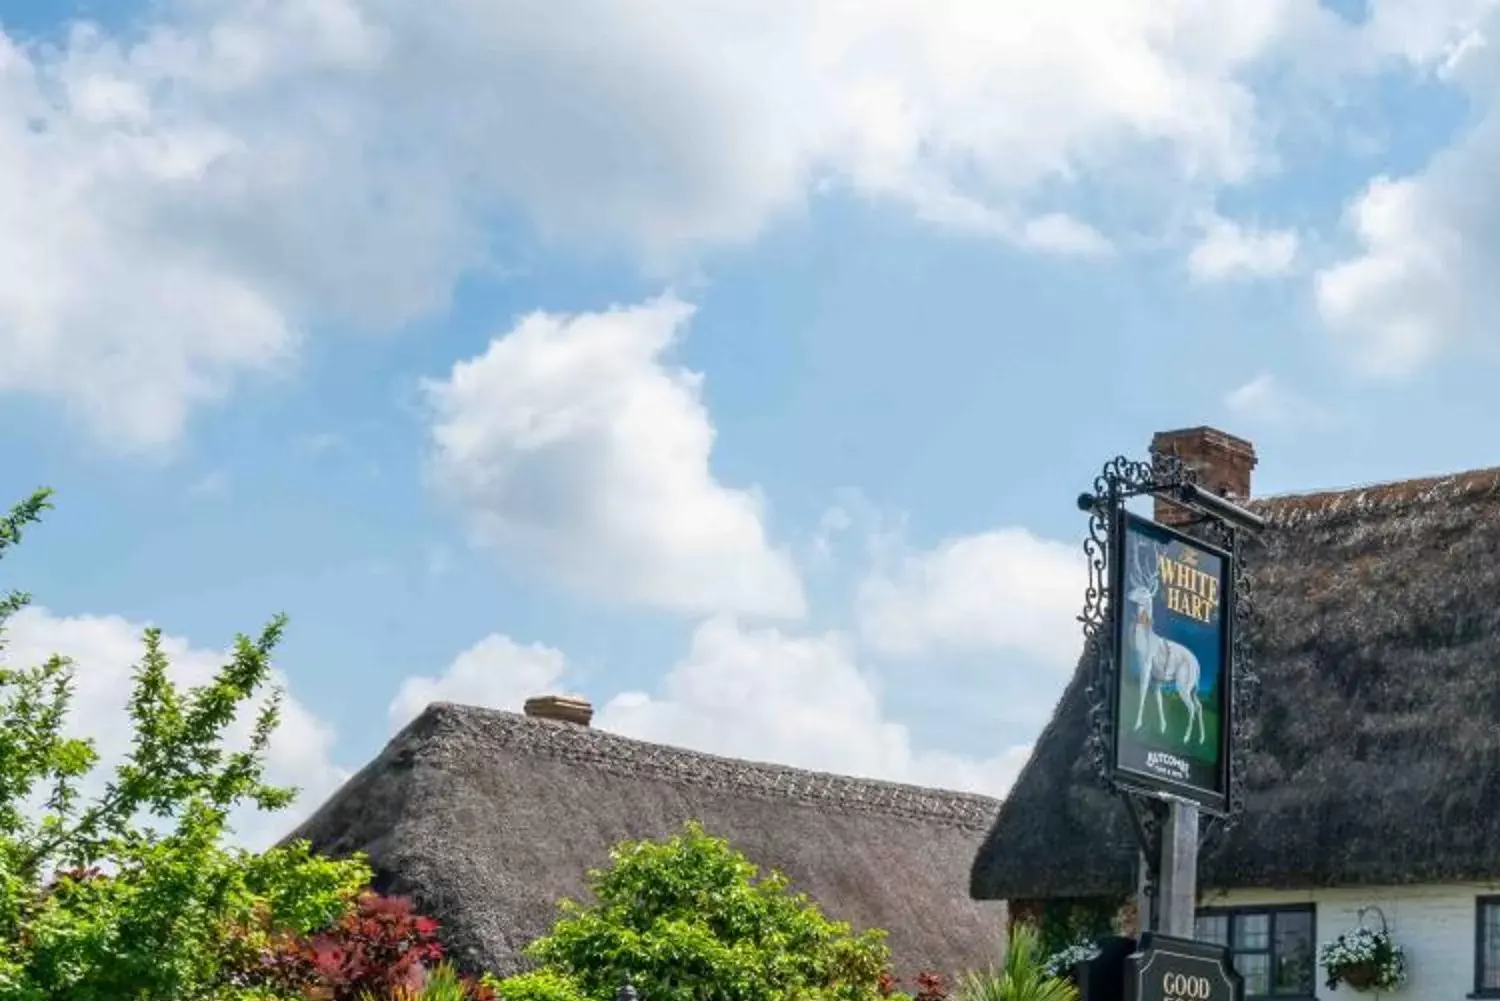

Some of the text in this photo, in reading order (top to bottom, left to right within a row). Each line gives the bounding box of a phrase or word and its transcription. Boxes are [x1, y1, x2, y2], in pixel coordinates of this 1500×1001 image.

[1158, 555, 1217, 602] WHITE
[1167, 587, 1213, 623] HART
[1163, 971, 1211, 1000] GOOD
